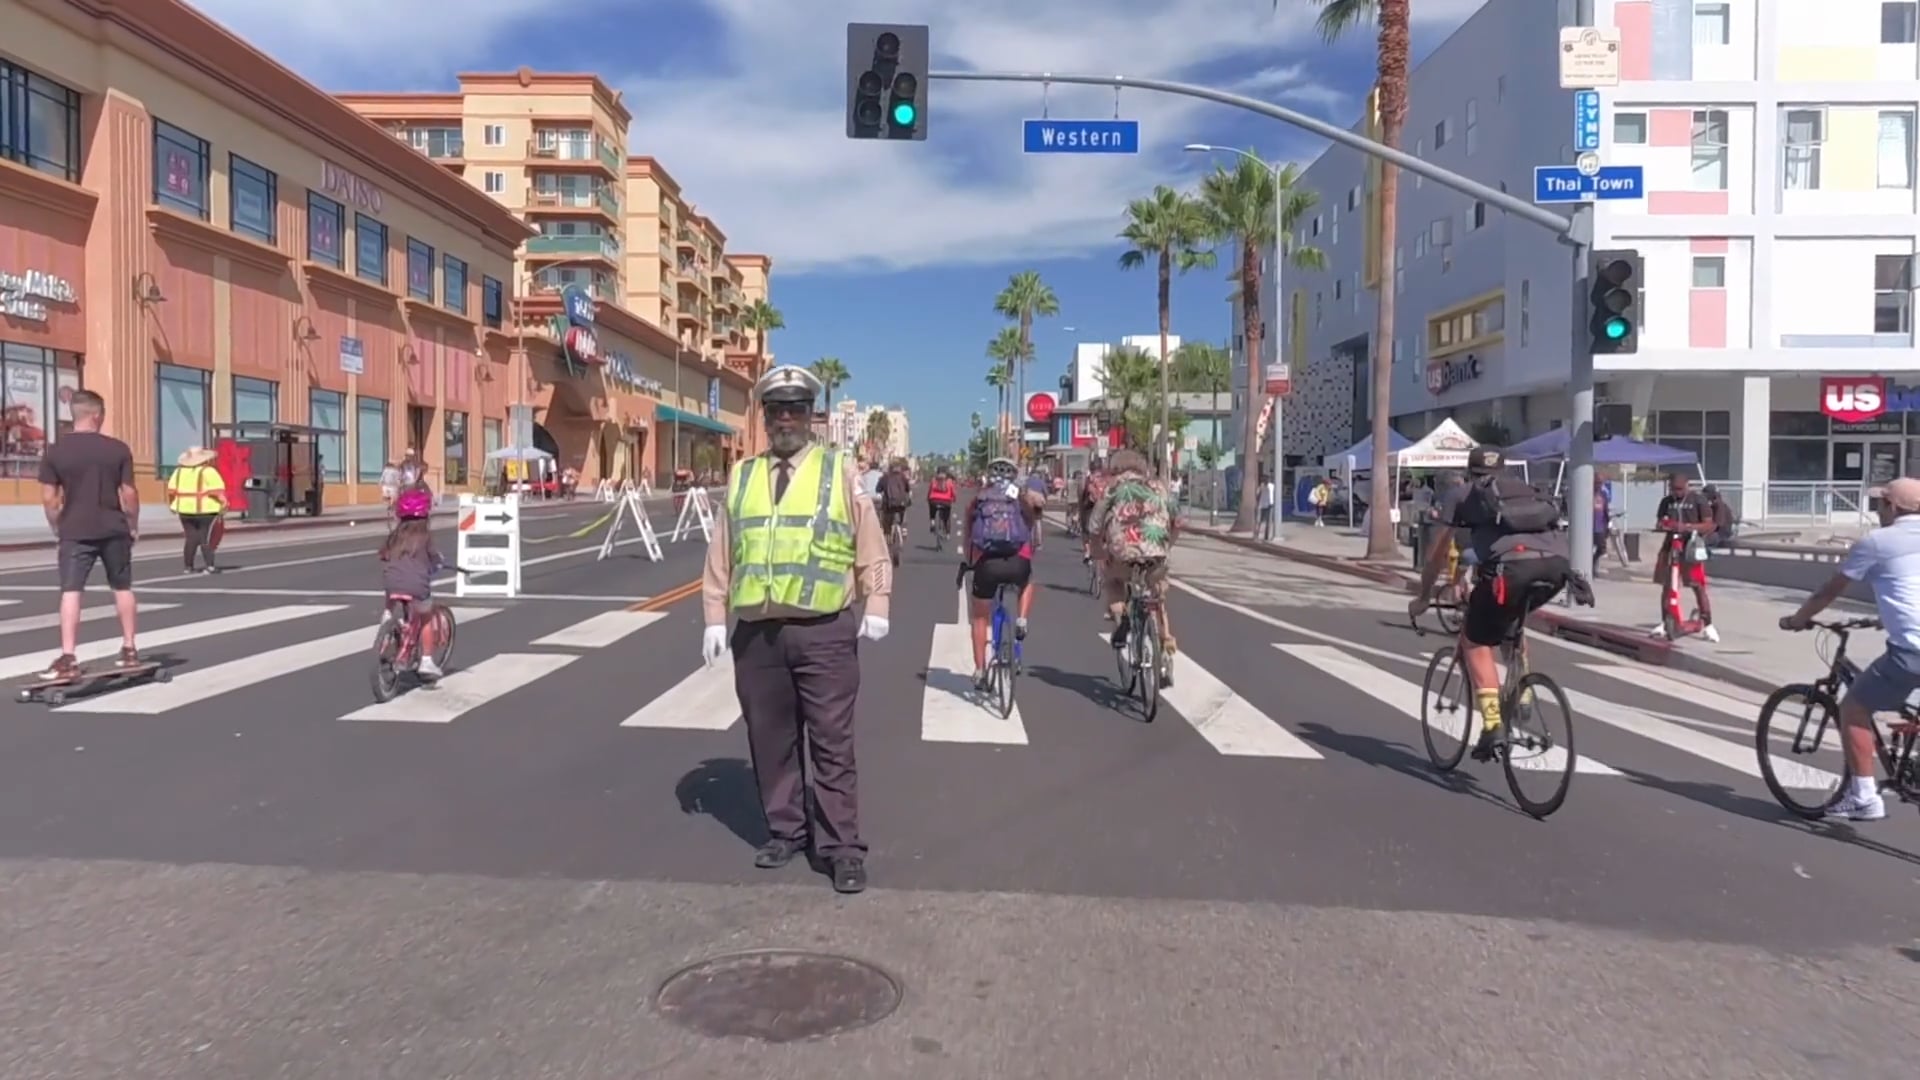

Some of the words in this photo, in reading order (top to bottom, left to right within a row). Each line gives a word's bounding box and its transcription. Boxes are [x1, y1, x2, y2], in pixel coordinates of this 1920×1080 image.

[1586, 94, 1598, 147] SYNC
[1041, 127, 1121, 146] Western
[321, 160, 382, 214] DAISO
[1545, 176, 1581, 191] Thai
[1590, 176, 1634, 190] Town
[1825, 384, 1880, 412] us
